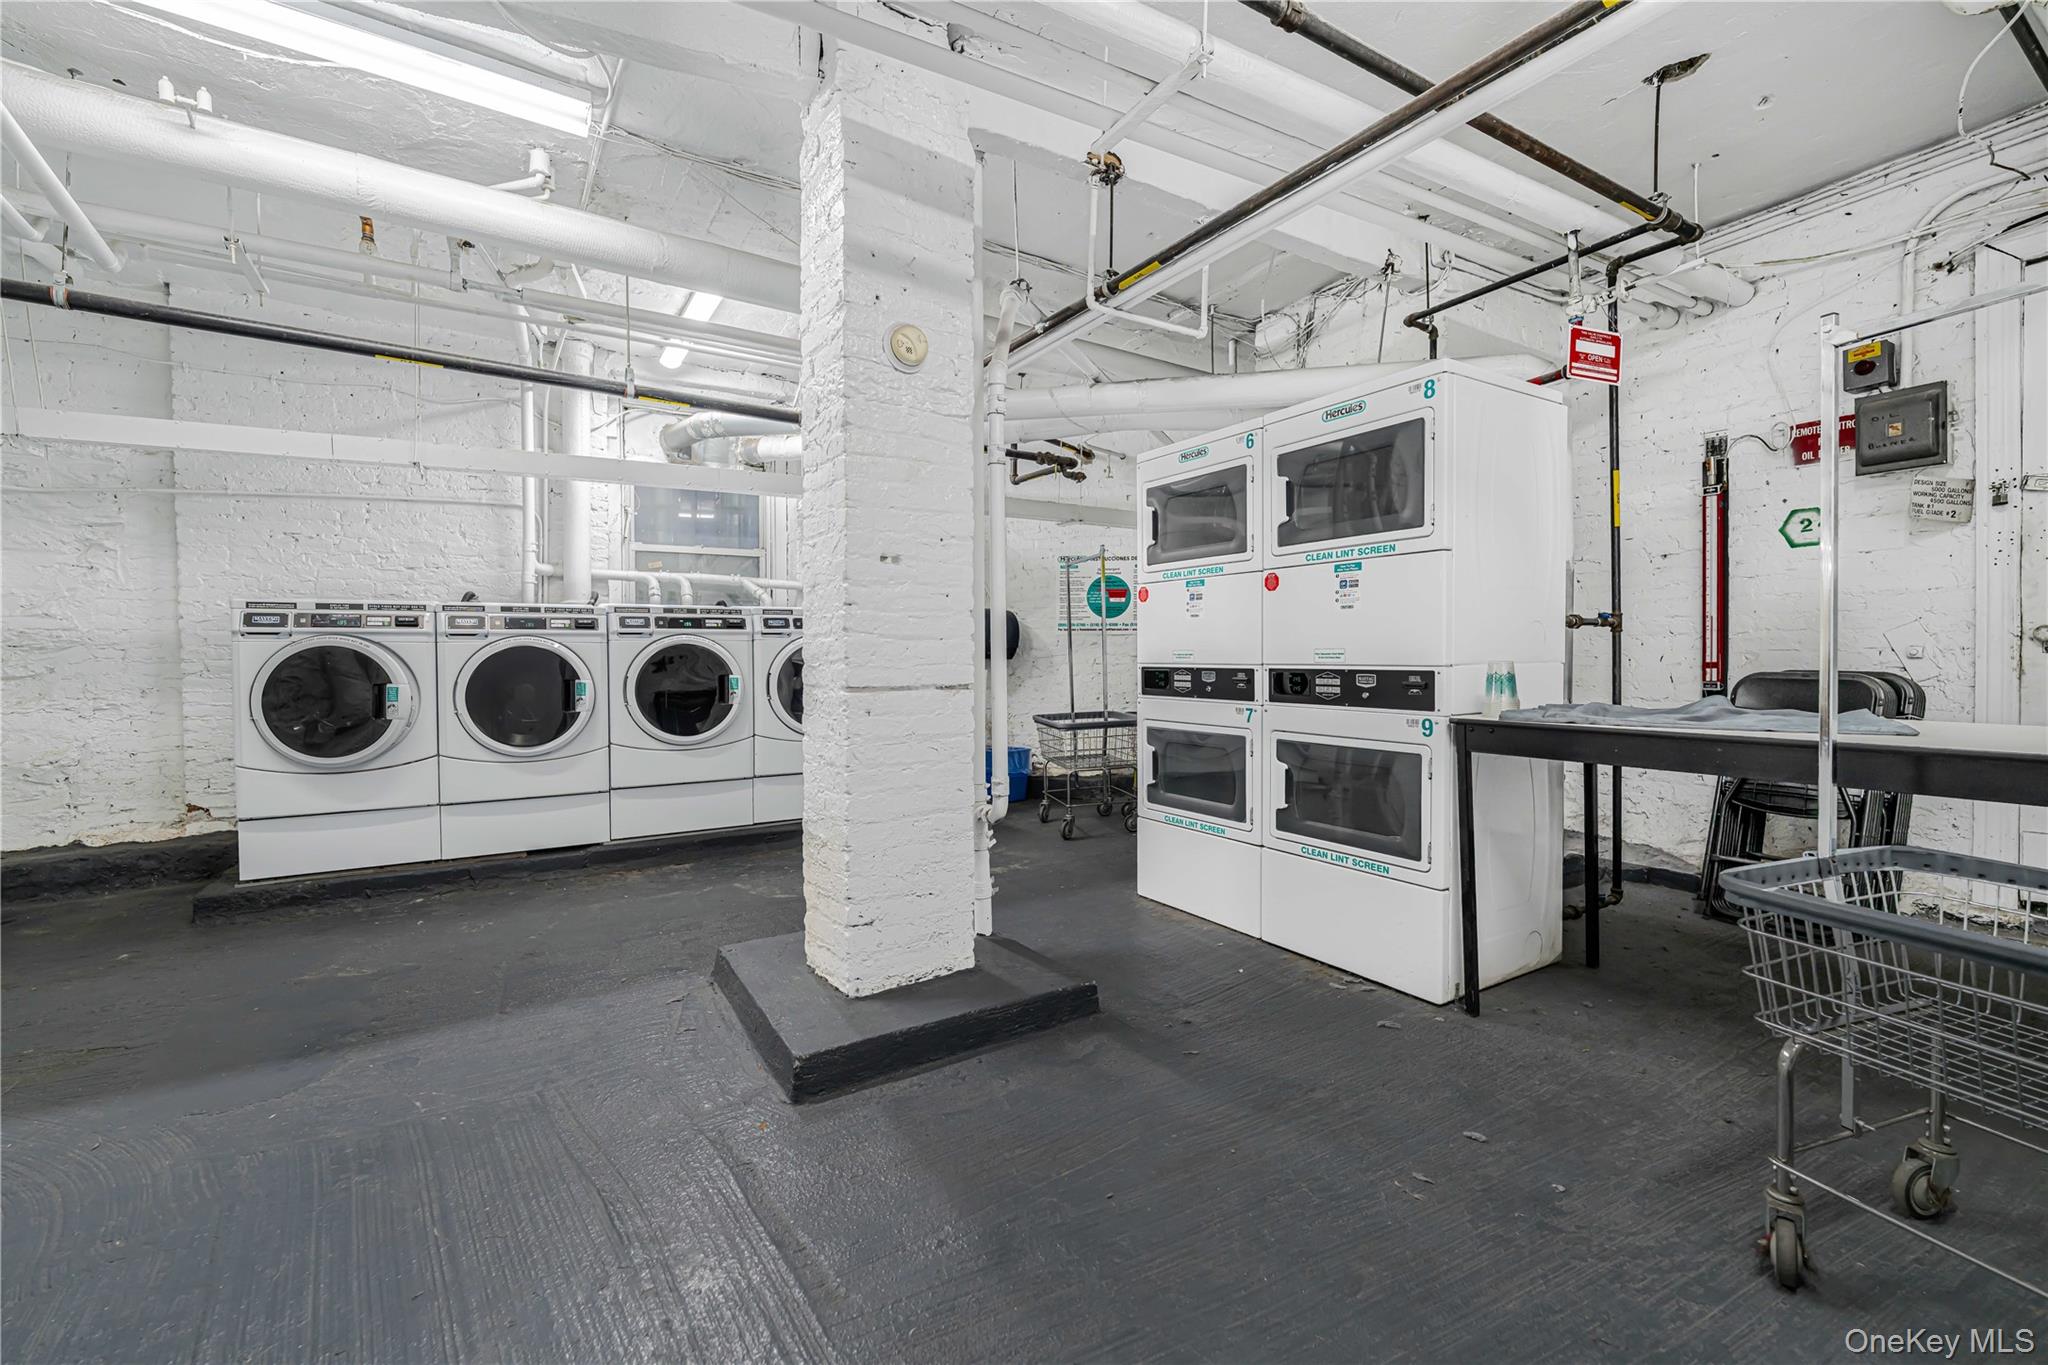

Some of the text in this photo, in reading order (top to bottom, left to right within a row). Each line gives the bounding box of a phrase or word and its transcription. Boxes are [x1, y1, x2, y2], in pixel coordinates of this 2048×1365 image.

[1587, 354, 1604, 363] OPEN
[1423, 379, 1436, 399] 8
[1325, 402, 1363, 420] Hercules
[1246, 432, 1254, 449] 6
[1180, 448, 1207, 461] Hercules
[1801, 451, 1815, 461] OIL
[1799, 518, 1813, 533] 2
[1305, 543, 1396, 562] CLEAN LINT SCREEN
[1162, 566, 1224, 579] CLEAN LINT SCREEN
[1245, 707, 1253, 723] 7
[1421, 717, 1434, 738] 9
[1164, 815, 1226, 835] CLEAN LINT SCREEN
[1301, 846, 1390, 875] CLEAN LINT SCREEN
